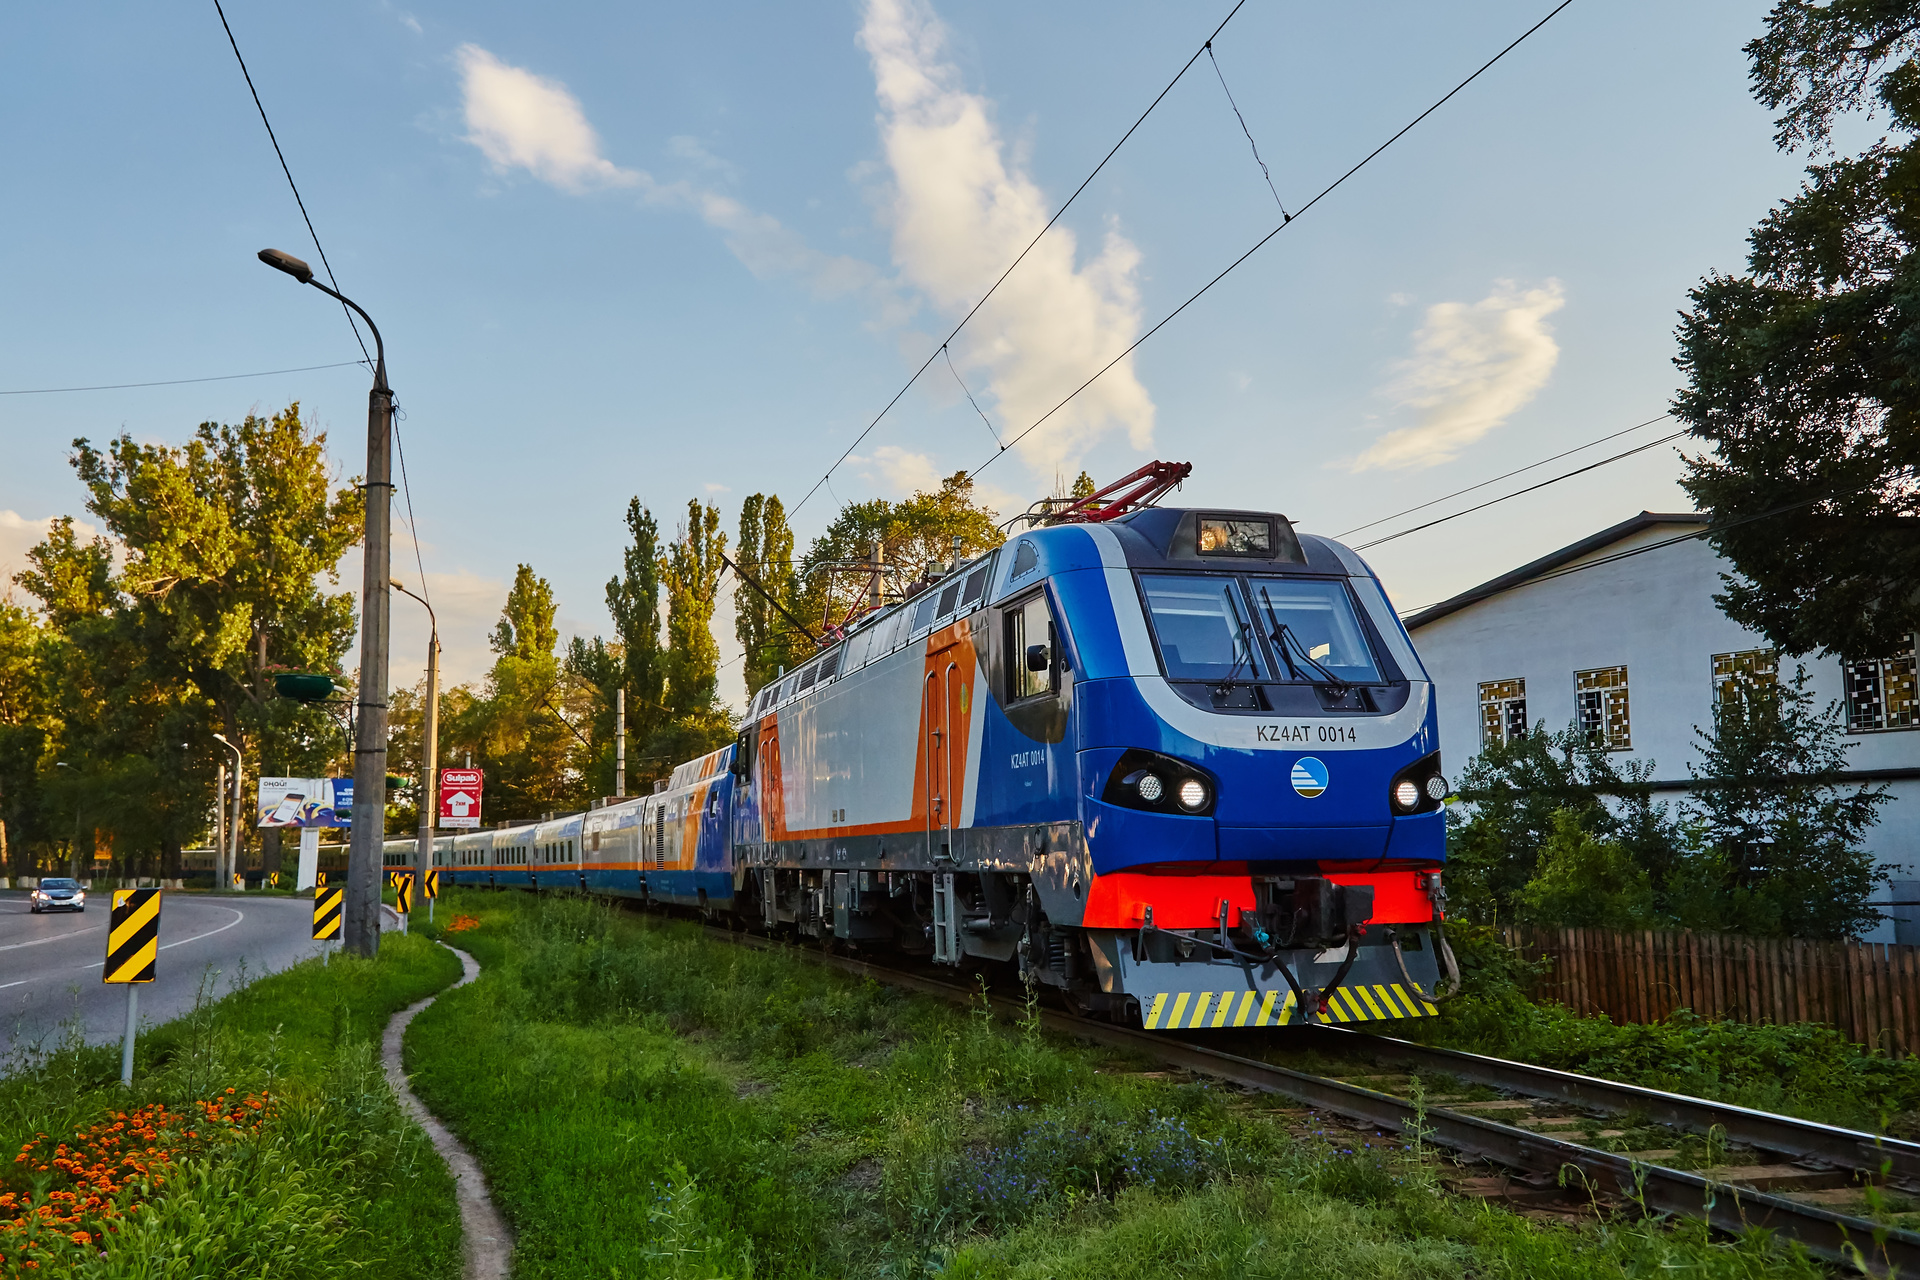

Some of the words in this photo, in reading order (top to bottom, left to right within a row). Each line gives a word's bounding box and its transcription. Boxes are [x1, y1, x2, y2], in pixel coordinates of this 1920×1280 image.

[1256, 725, 1311, 742] KZ4AT
[1318, 726, 1356, 743] 0014
[1010, 751, 1029, 769] KZ4AT
[1030, 749, 1045, 766] 0014
[446, 774, 477, 783] Sulpak
